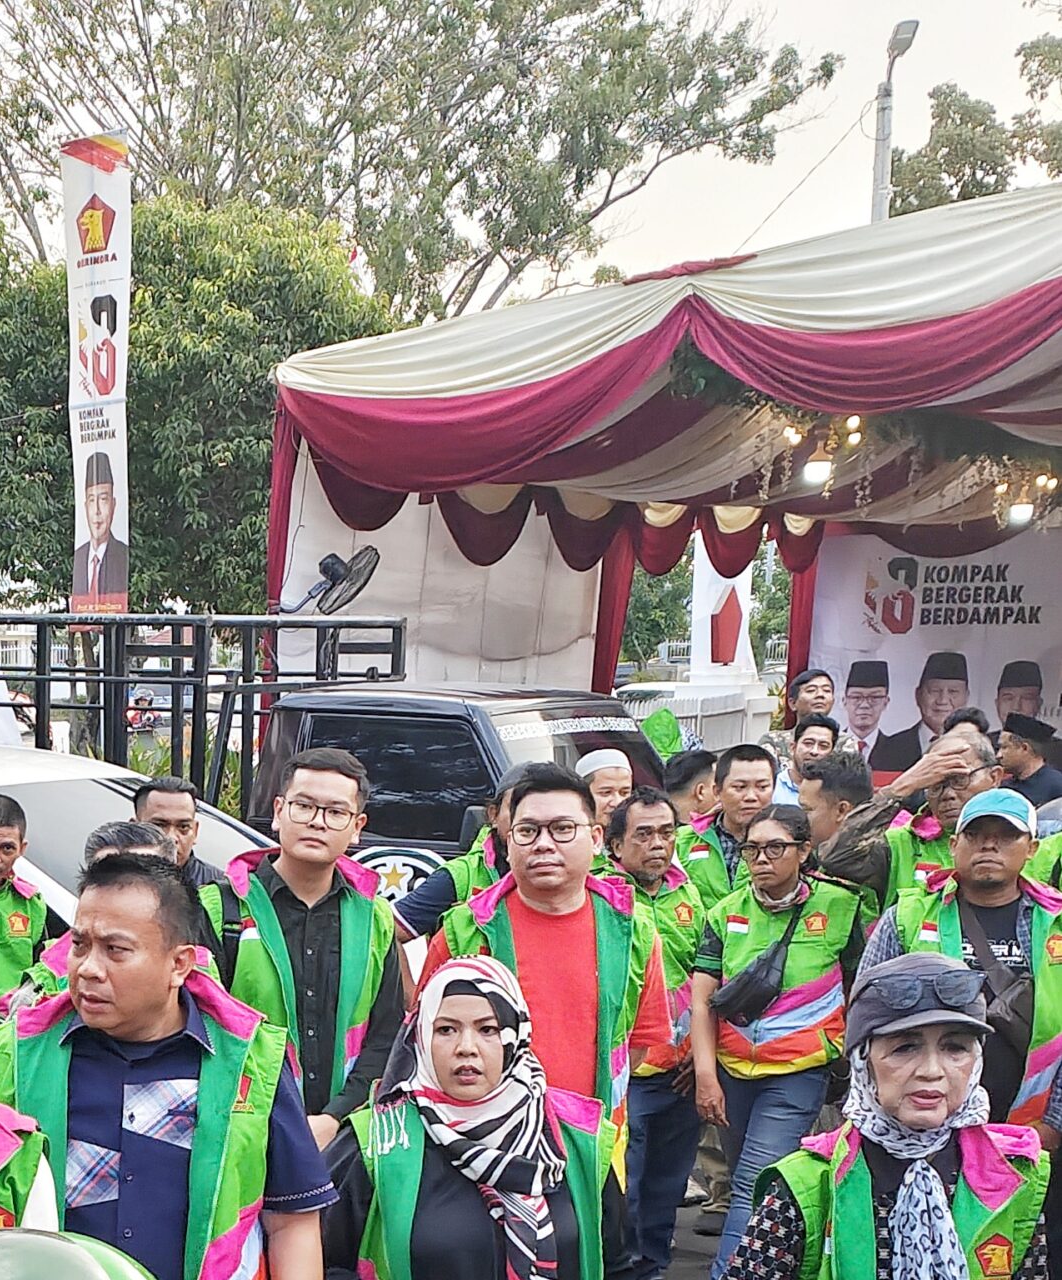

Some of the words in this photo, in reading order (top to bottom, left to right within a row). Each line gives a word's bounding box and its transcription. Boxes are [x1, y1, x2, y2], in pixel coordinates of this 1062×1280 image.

[78, 406, 105, 421] KOMPAK
[923, 563, 1010, 584] KOMPAK
[921, 584, 1024, 605] BERGERAK
[919, 606, 1042, 626] BERDAMPAK
